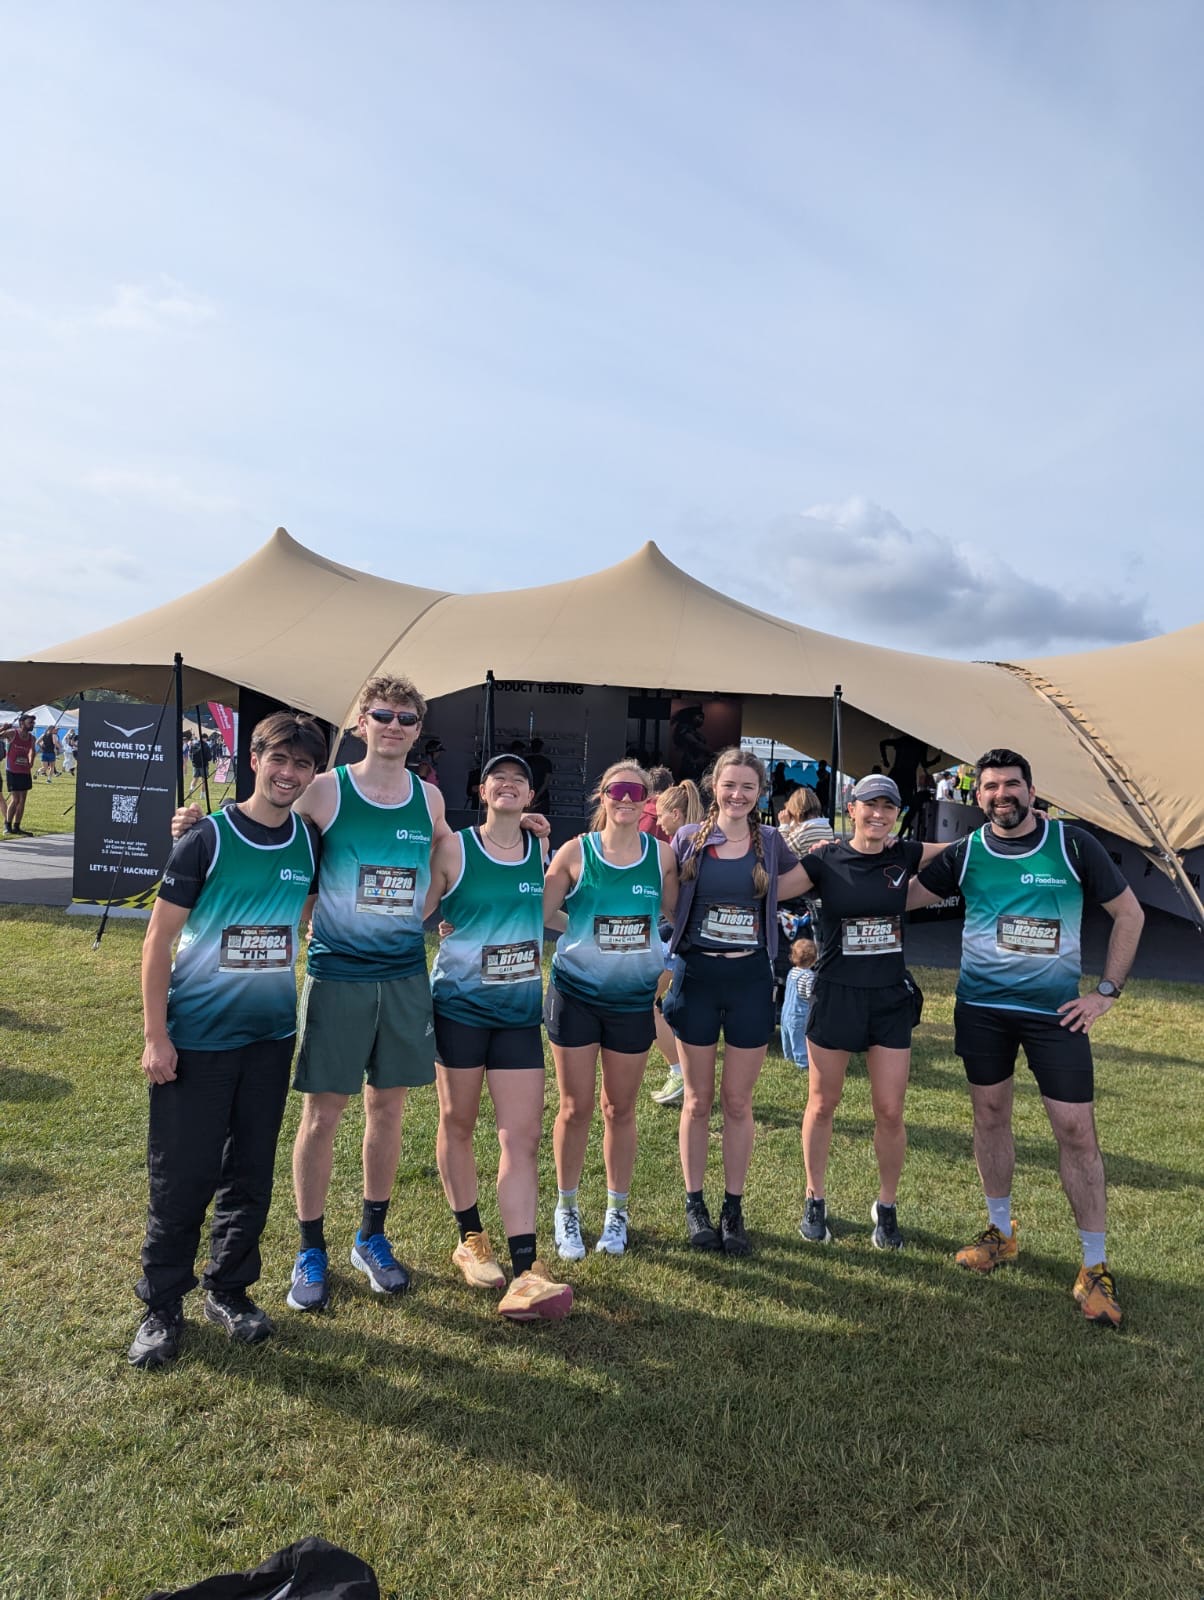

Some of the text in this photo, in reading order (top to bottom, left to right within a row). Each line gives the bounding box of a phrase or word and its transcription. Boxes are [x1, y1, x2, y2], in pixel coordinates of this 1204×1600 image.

[536, 684, 584, 695] TESTING
[94, 741, 133, 750] WELCOME
[135, 743, 145, 751] TO
[92, 750, 115, 758] HOKA
[90, 864, 108, 872] LET'S
[123, 866, 159, 875] HACKNEY
[383, 876, 414, 890] D1219
[1035, 877, 1067, 885] Foodbank
[719, 913, 754, 926] H18973
[613, 924, 645, 936] B11097
[862, 924, 892, 936] E7253
[1014, 925, 1058, 939] H26523
[239, 950, 268, 959] TIM
[499, 950, 535, 966] B17045
